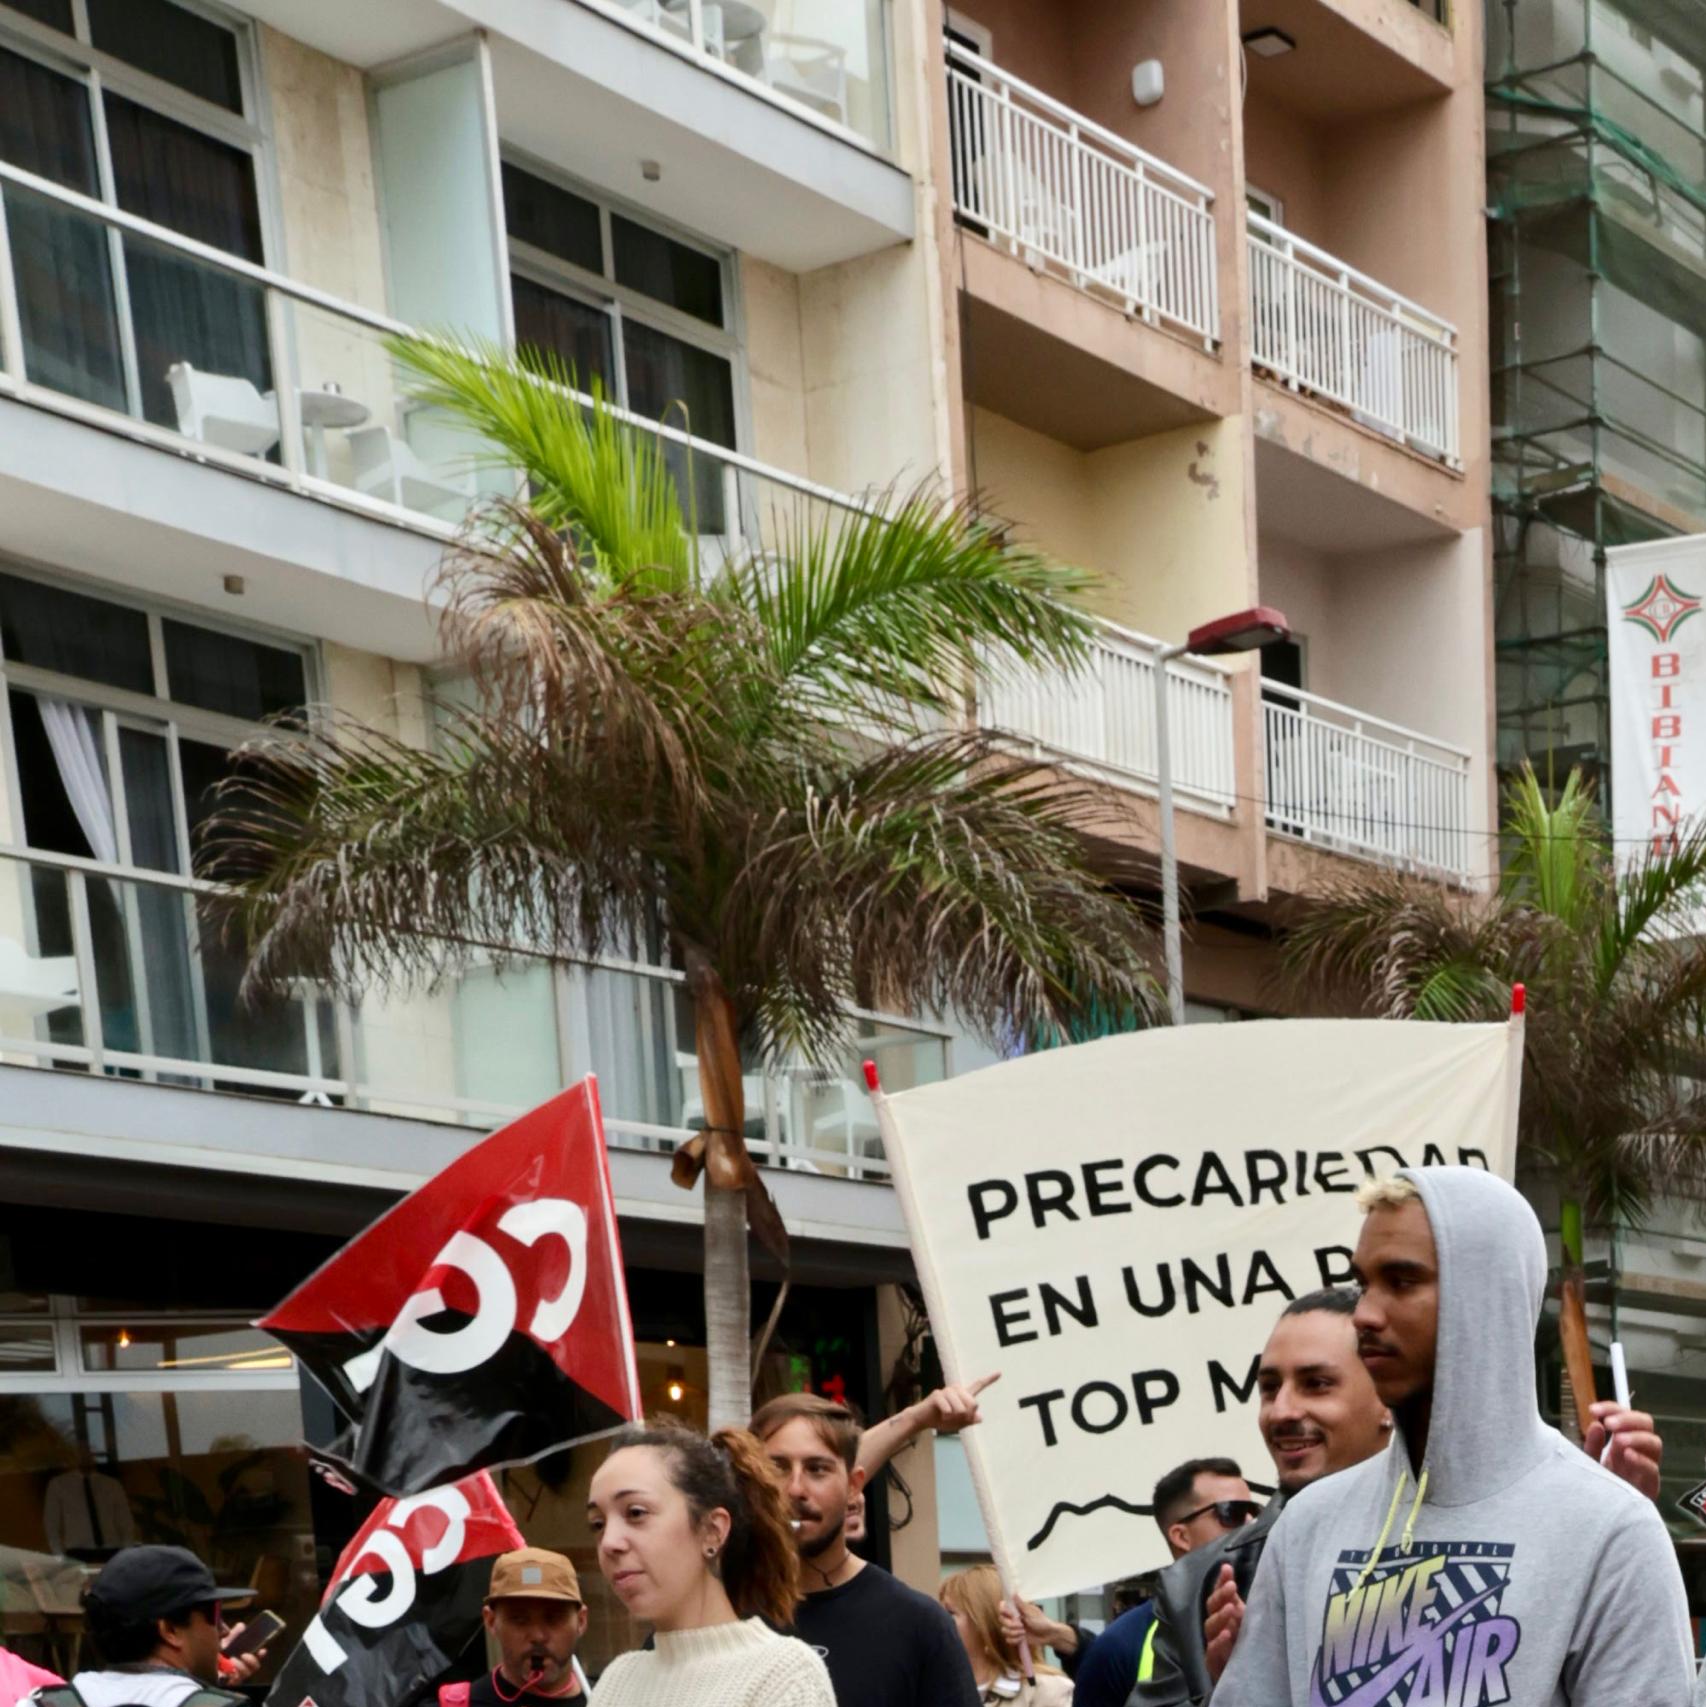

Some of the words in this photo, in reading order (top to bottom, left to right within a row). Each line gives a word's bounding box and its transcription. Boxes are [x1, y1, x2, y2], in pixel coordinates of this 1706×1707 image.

[989, 1275, 1099, 1348] EN
[1122, 1250, 1295, 1319] UNA
[1019, 1369, 1180, 1447] TOP
[1321, 1554, 1448, 1682] NIKE
